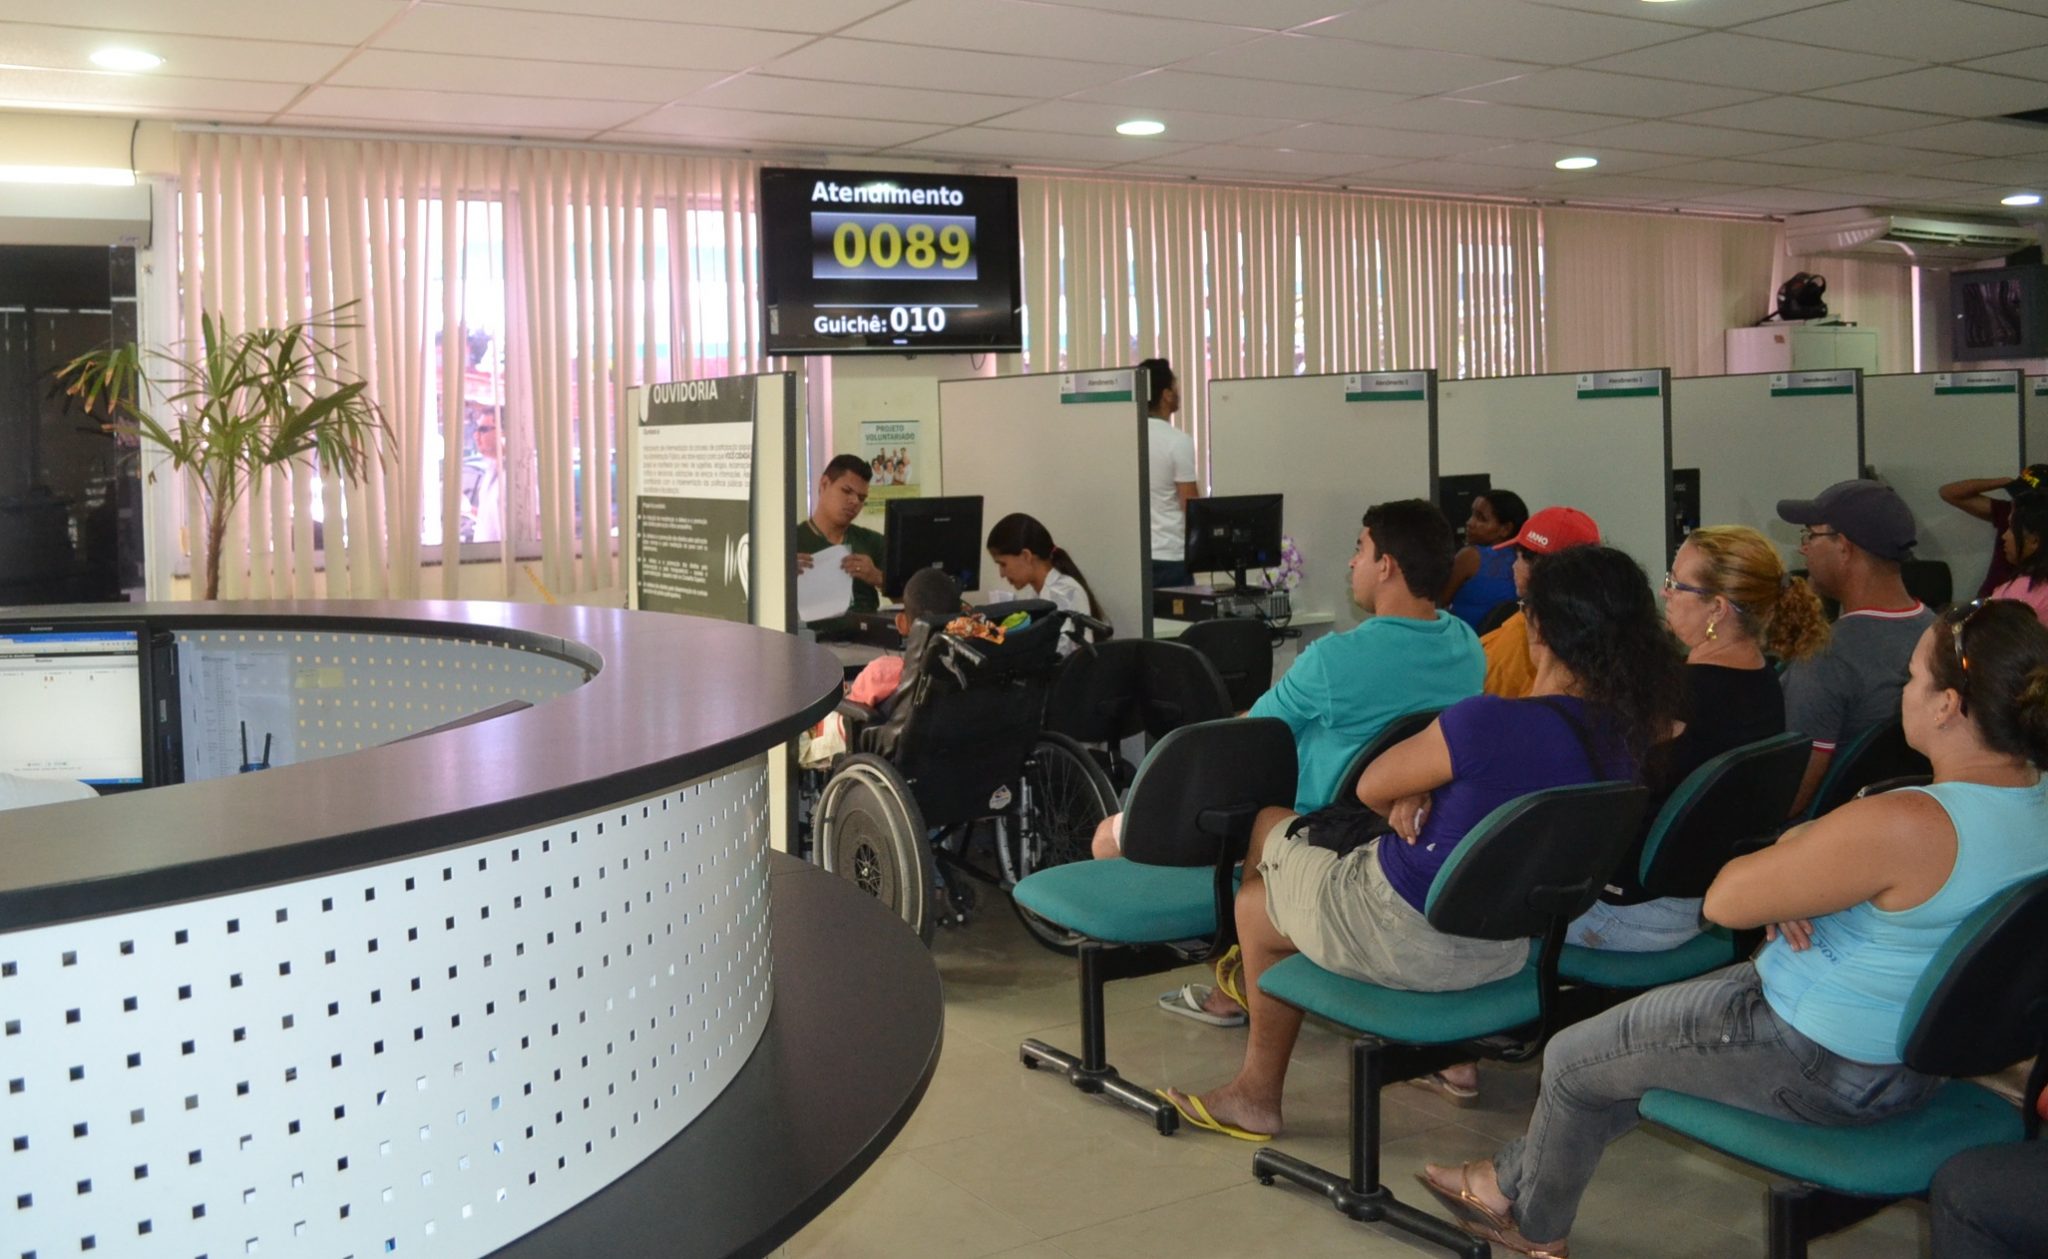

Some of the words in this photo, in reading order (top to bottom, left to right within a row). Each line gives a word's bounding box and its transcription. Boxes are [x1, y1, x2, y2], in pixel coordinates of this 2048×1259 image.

[811, 181, 964, 206] Atendimento
[833, 222, 970, 269] 0089
[813, 314, 887, 333] Guichê:
[890, 306, 946, 332] 010
[653, 380, 719, 404] OUVIDORIA
[865, 432, 916, 442] VOLUNTARIADO
[875, 424, 905, 433] PROJETO
